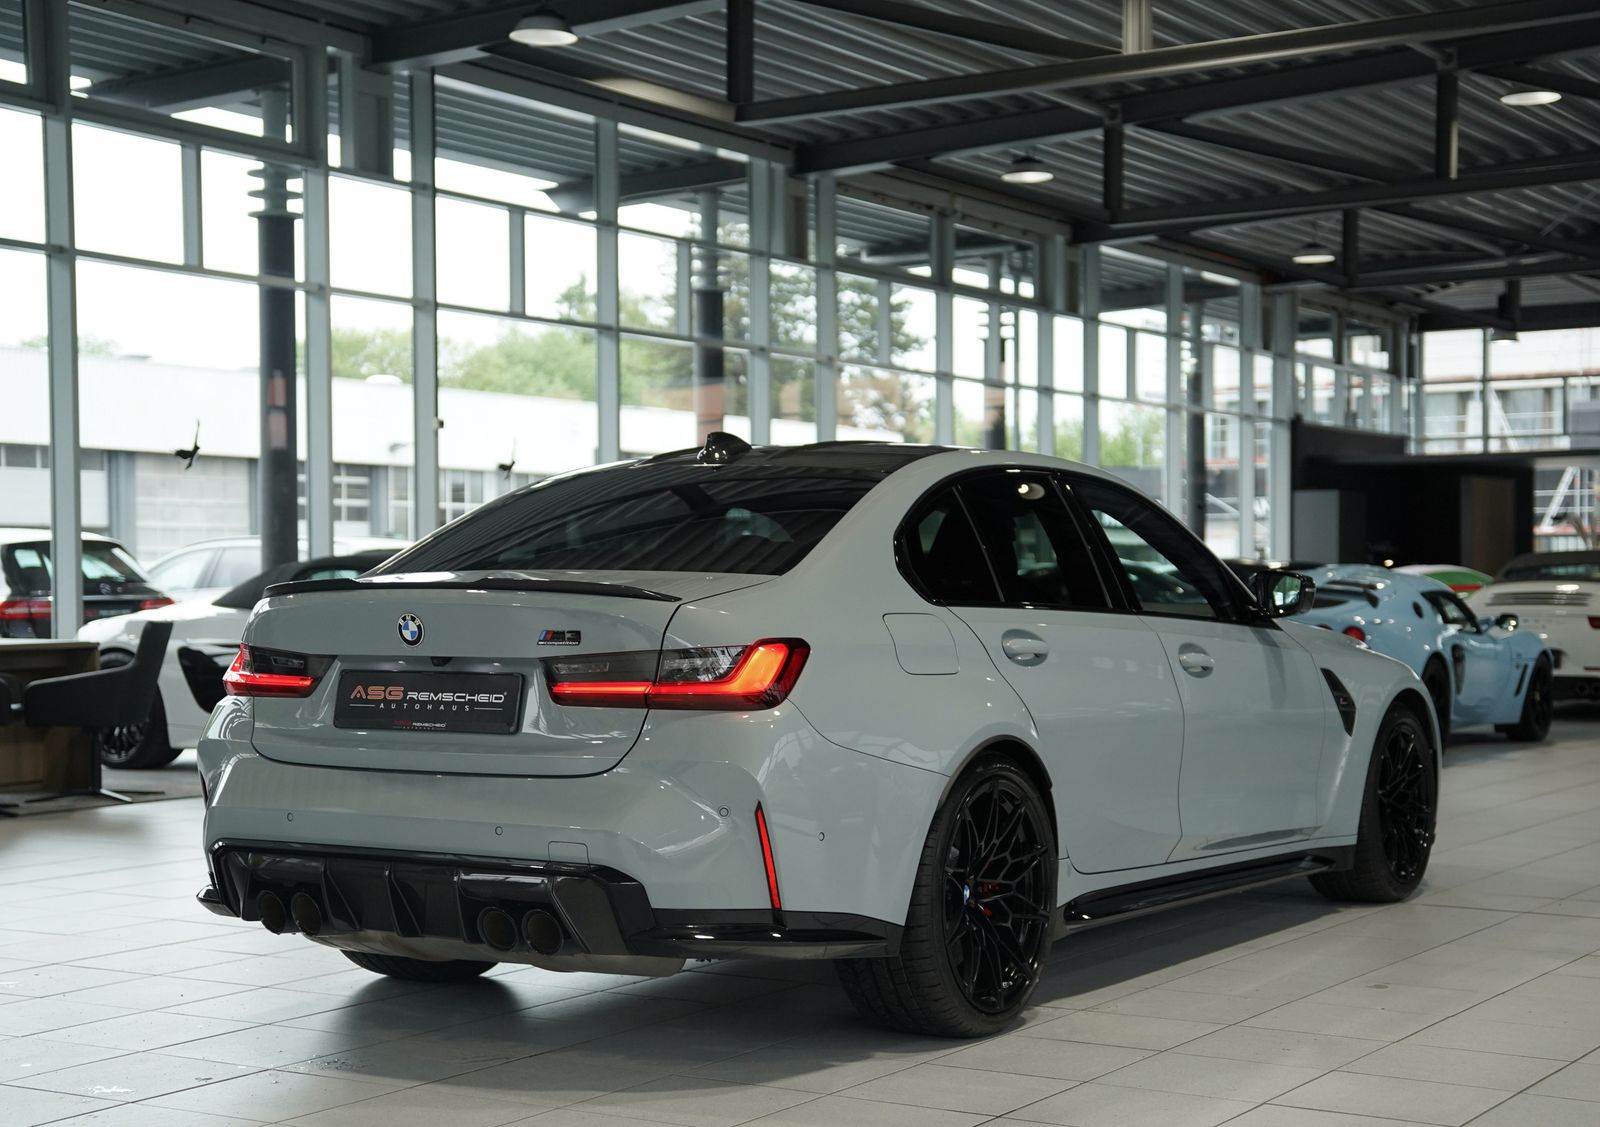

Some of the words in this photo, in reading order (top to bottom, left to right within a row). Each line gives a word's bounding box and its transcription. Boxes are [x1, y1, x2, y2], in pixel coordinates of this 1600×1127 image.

[350, 684, 404, 700] ASG
[406, 691, 505, 703] REMSCHEID
[379, 703, 470, 712] AUTOHAUS
